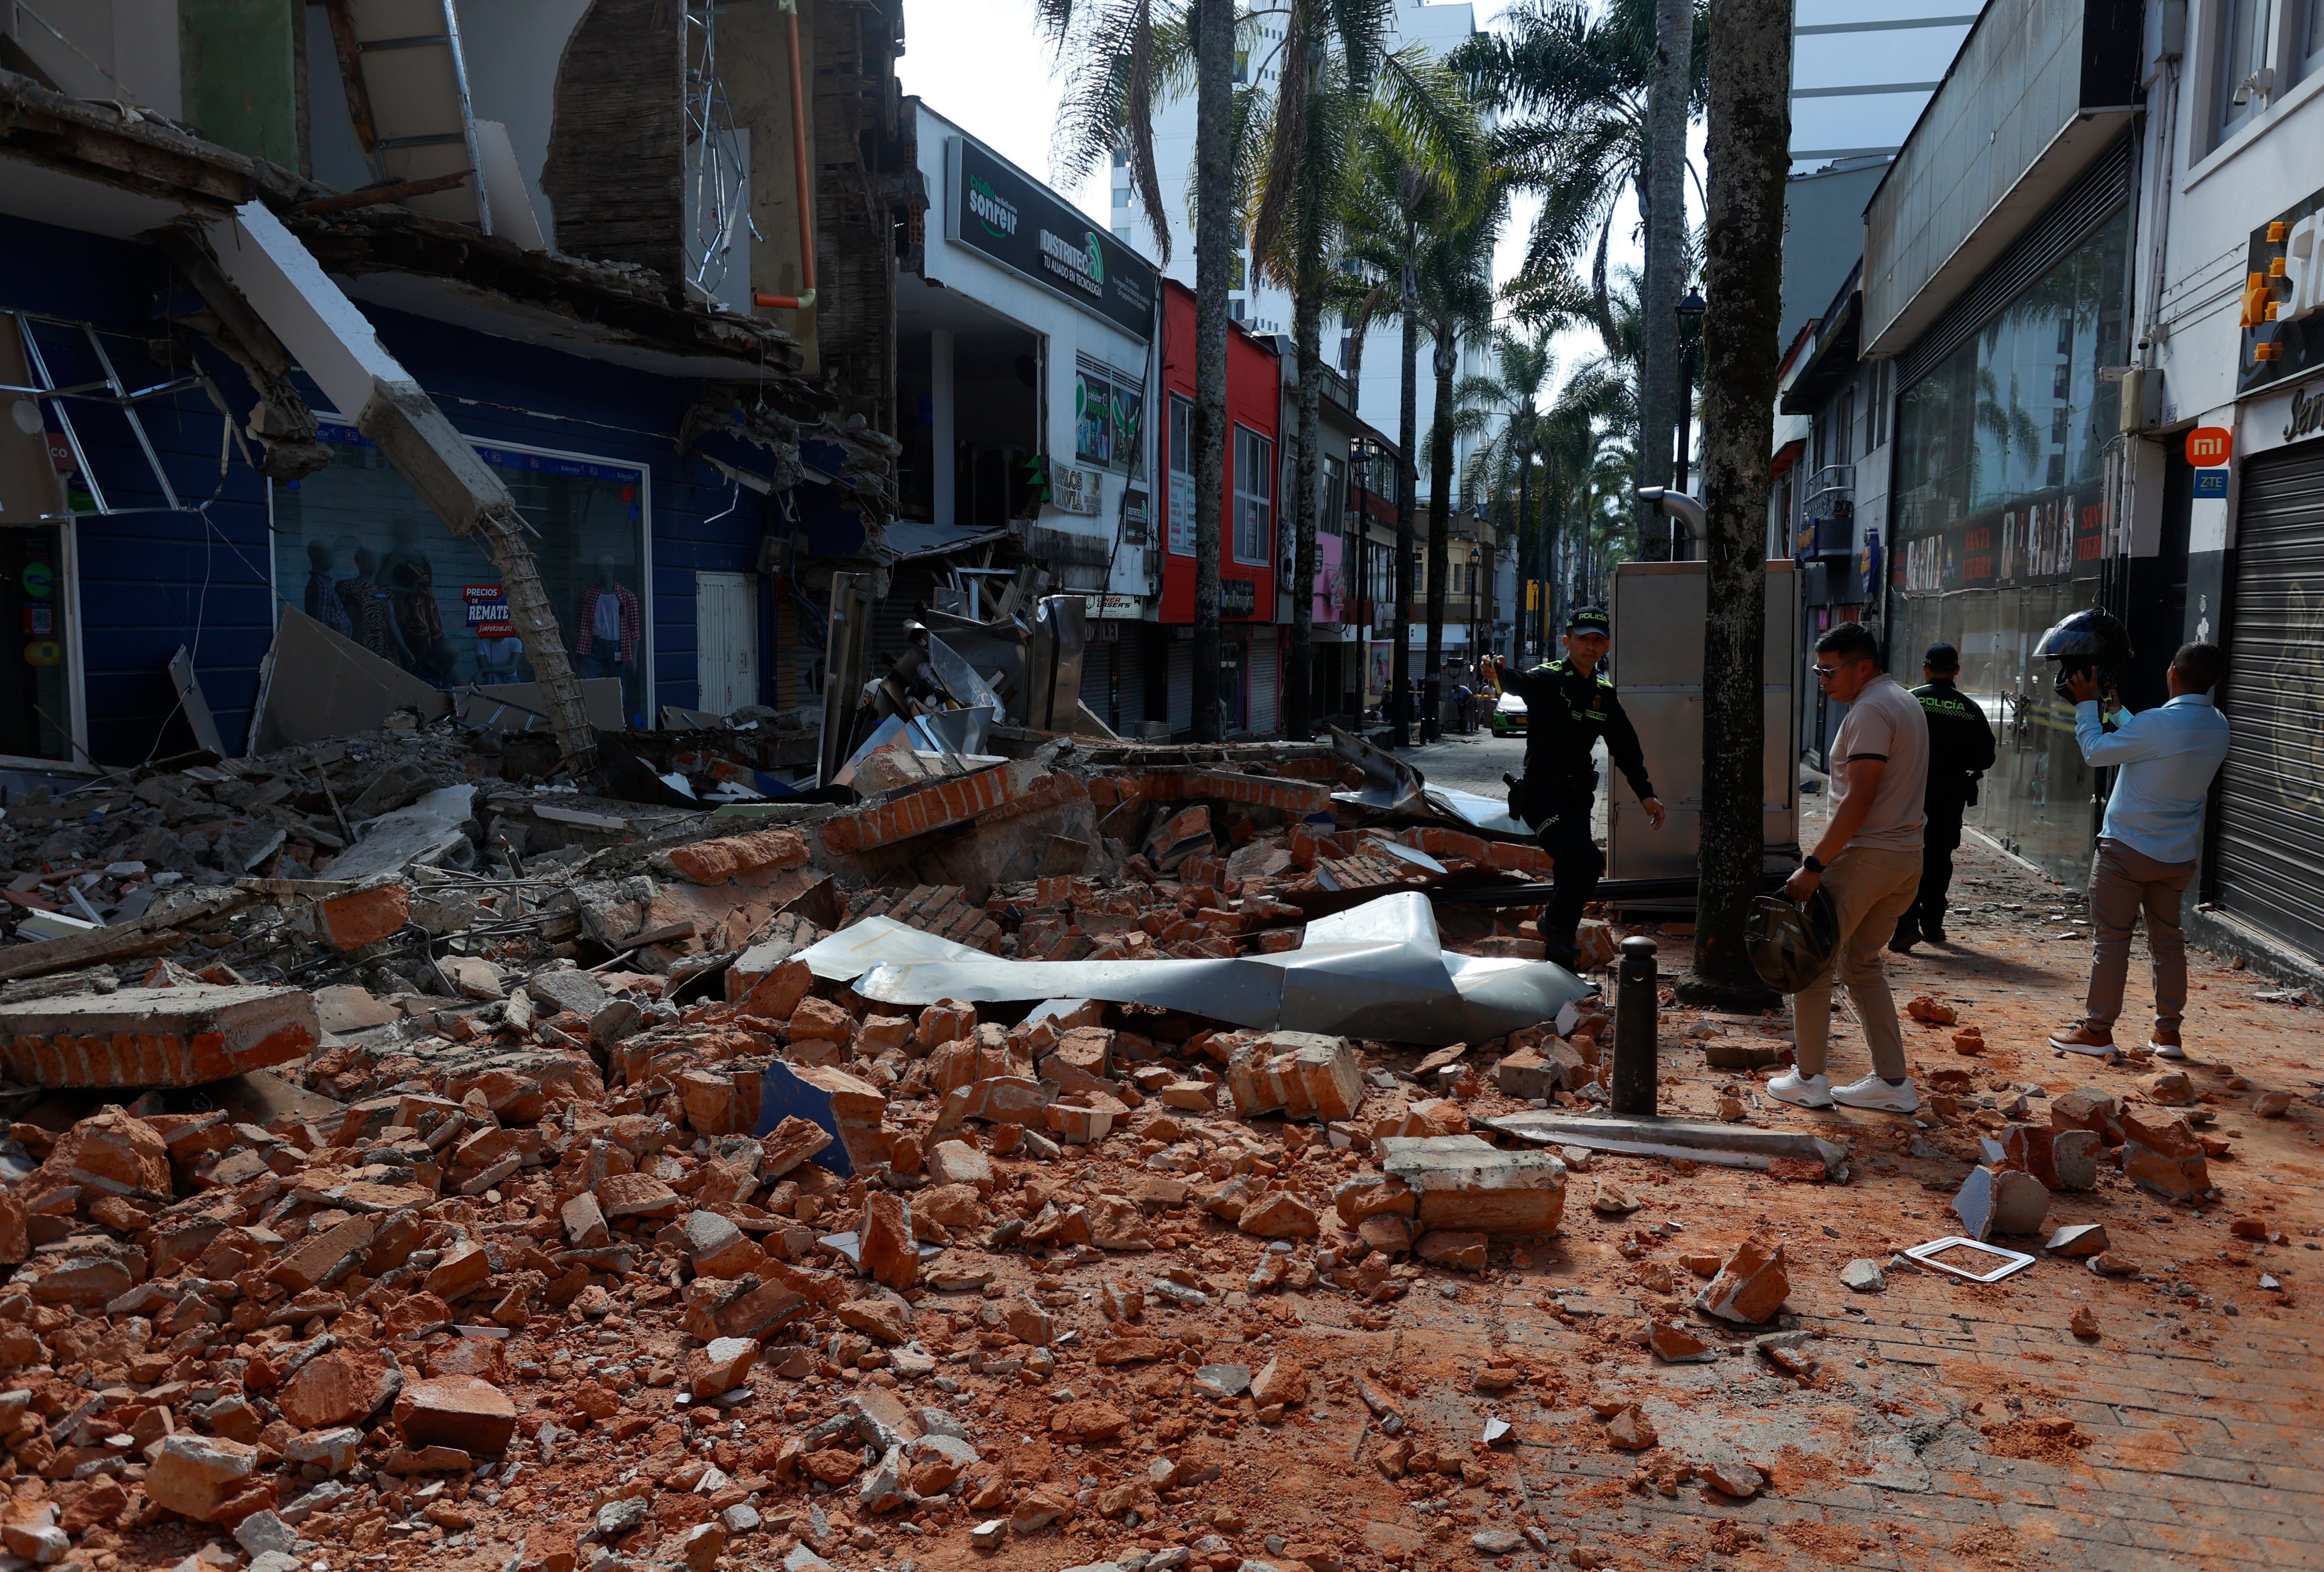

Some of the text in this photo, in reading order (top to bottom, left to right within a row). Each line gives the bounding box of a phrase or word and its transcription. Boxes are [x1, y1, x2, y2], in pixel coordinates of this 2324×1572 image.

[971, 174, 995, 200] Crédito
[1042, 229, 1088, 275] DISTRITEC
[1044, 254, 1102, 298] TU ALIADO EN TECNOLOGÍA
[1088, 391, 1102, 404] celular
[561, 465, 581, 473] Kalendar
[2200, 477, 2224, 488] ZTE
[1964, 527, 1991, 552] SANTA
[2077, 535, 2103, 561] TIER
[1961, 556, 1991, 580] TIERRA
[466, 588, 498, 597] PRECIOS
[468, 605, 509, 621] REMATE
[1578, 612, 1607, 623] POLICÍA
[479, 625, 513, 633] ¡IMPERDIBLES!
[1085, 622, 1119, 641] OLET
[1917, 696, 1965, 712] POLICÍA
